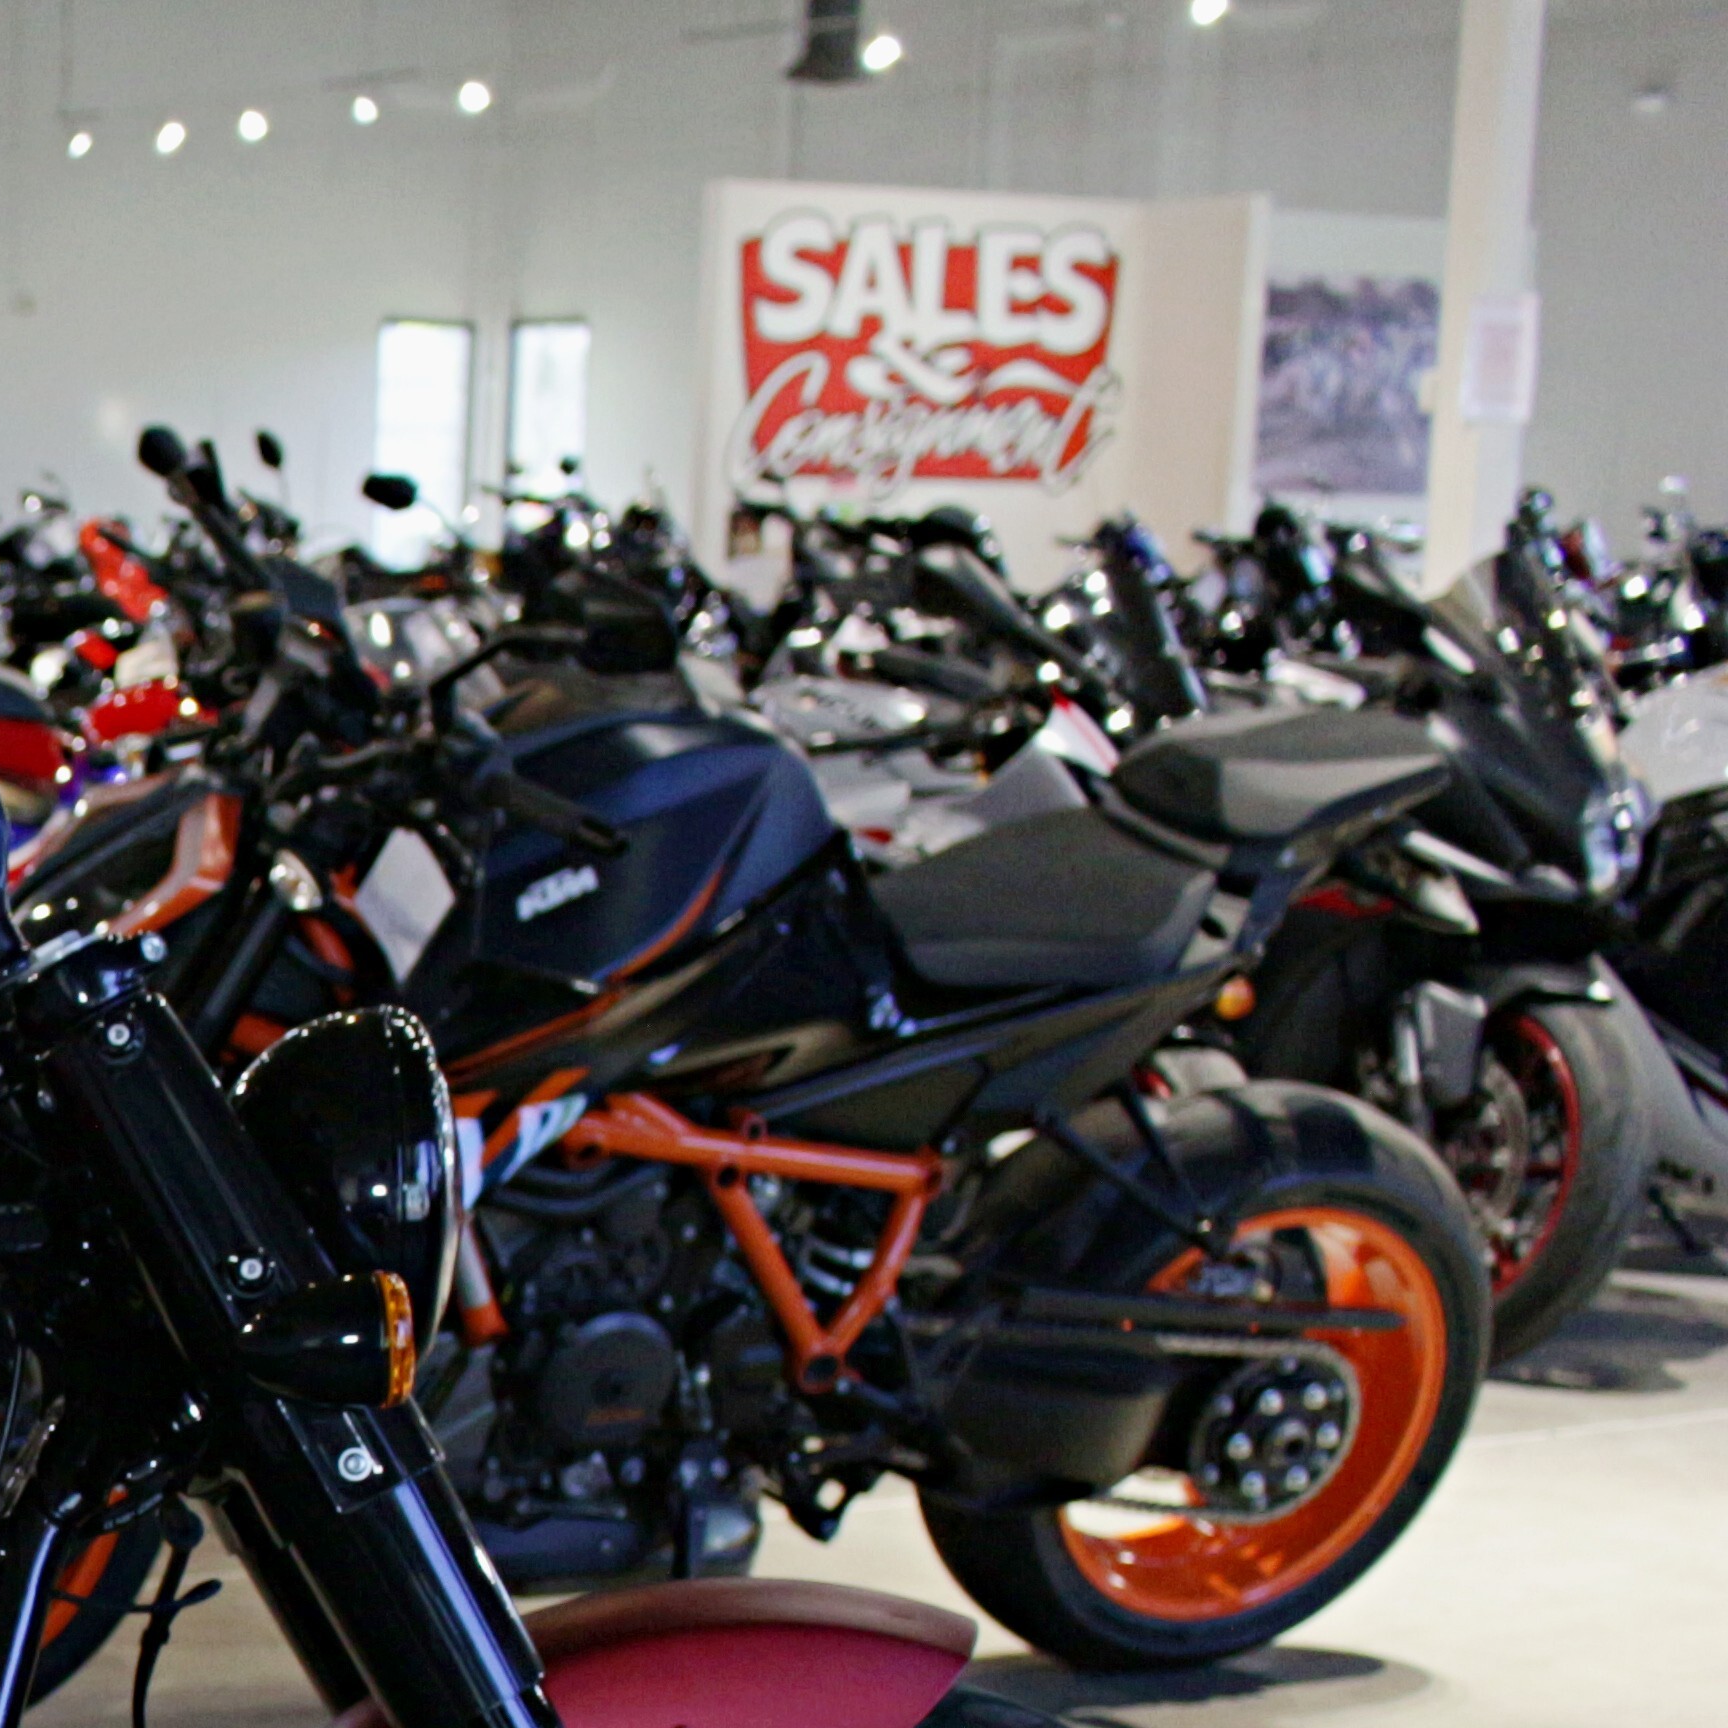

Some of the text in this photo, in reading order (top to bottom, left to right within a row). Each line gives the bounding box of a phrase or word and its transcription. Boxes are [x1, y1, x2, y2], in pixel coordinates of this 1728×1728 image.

[753, 208, 1114, 355] SALES
[727, 350, 1122, 496] Consignment
[515, 864, 600, 923] KTM
